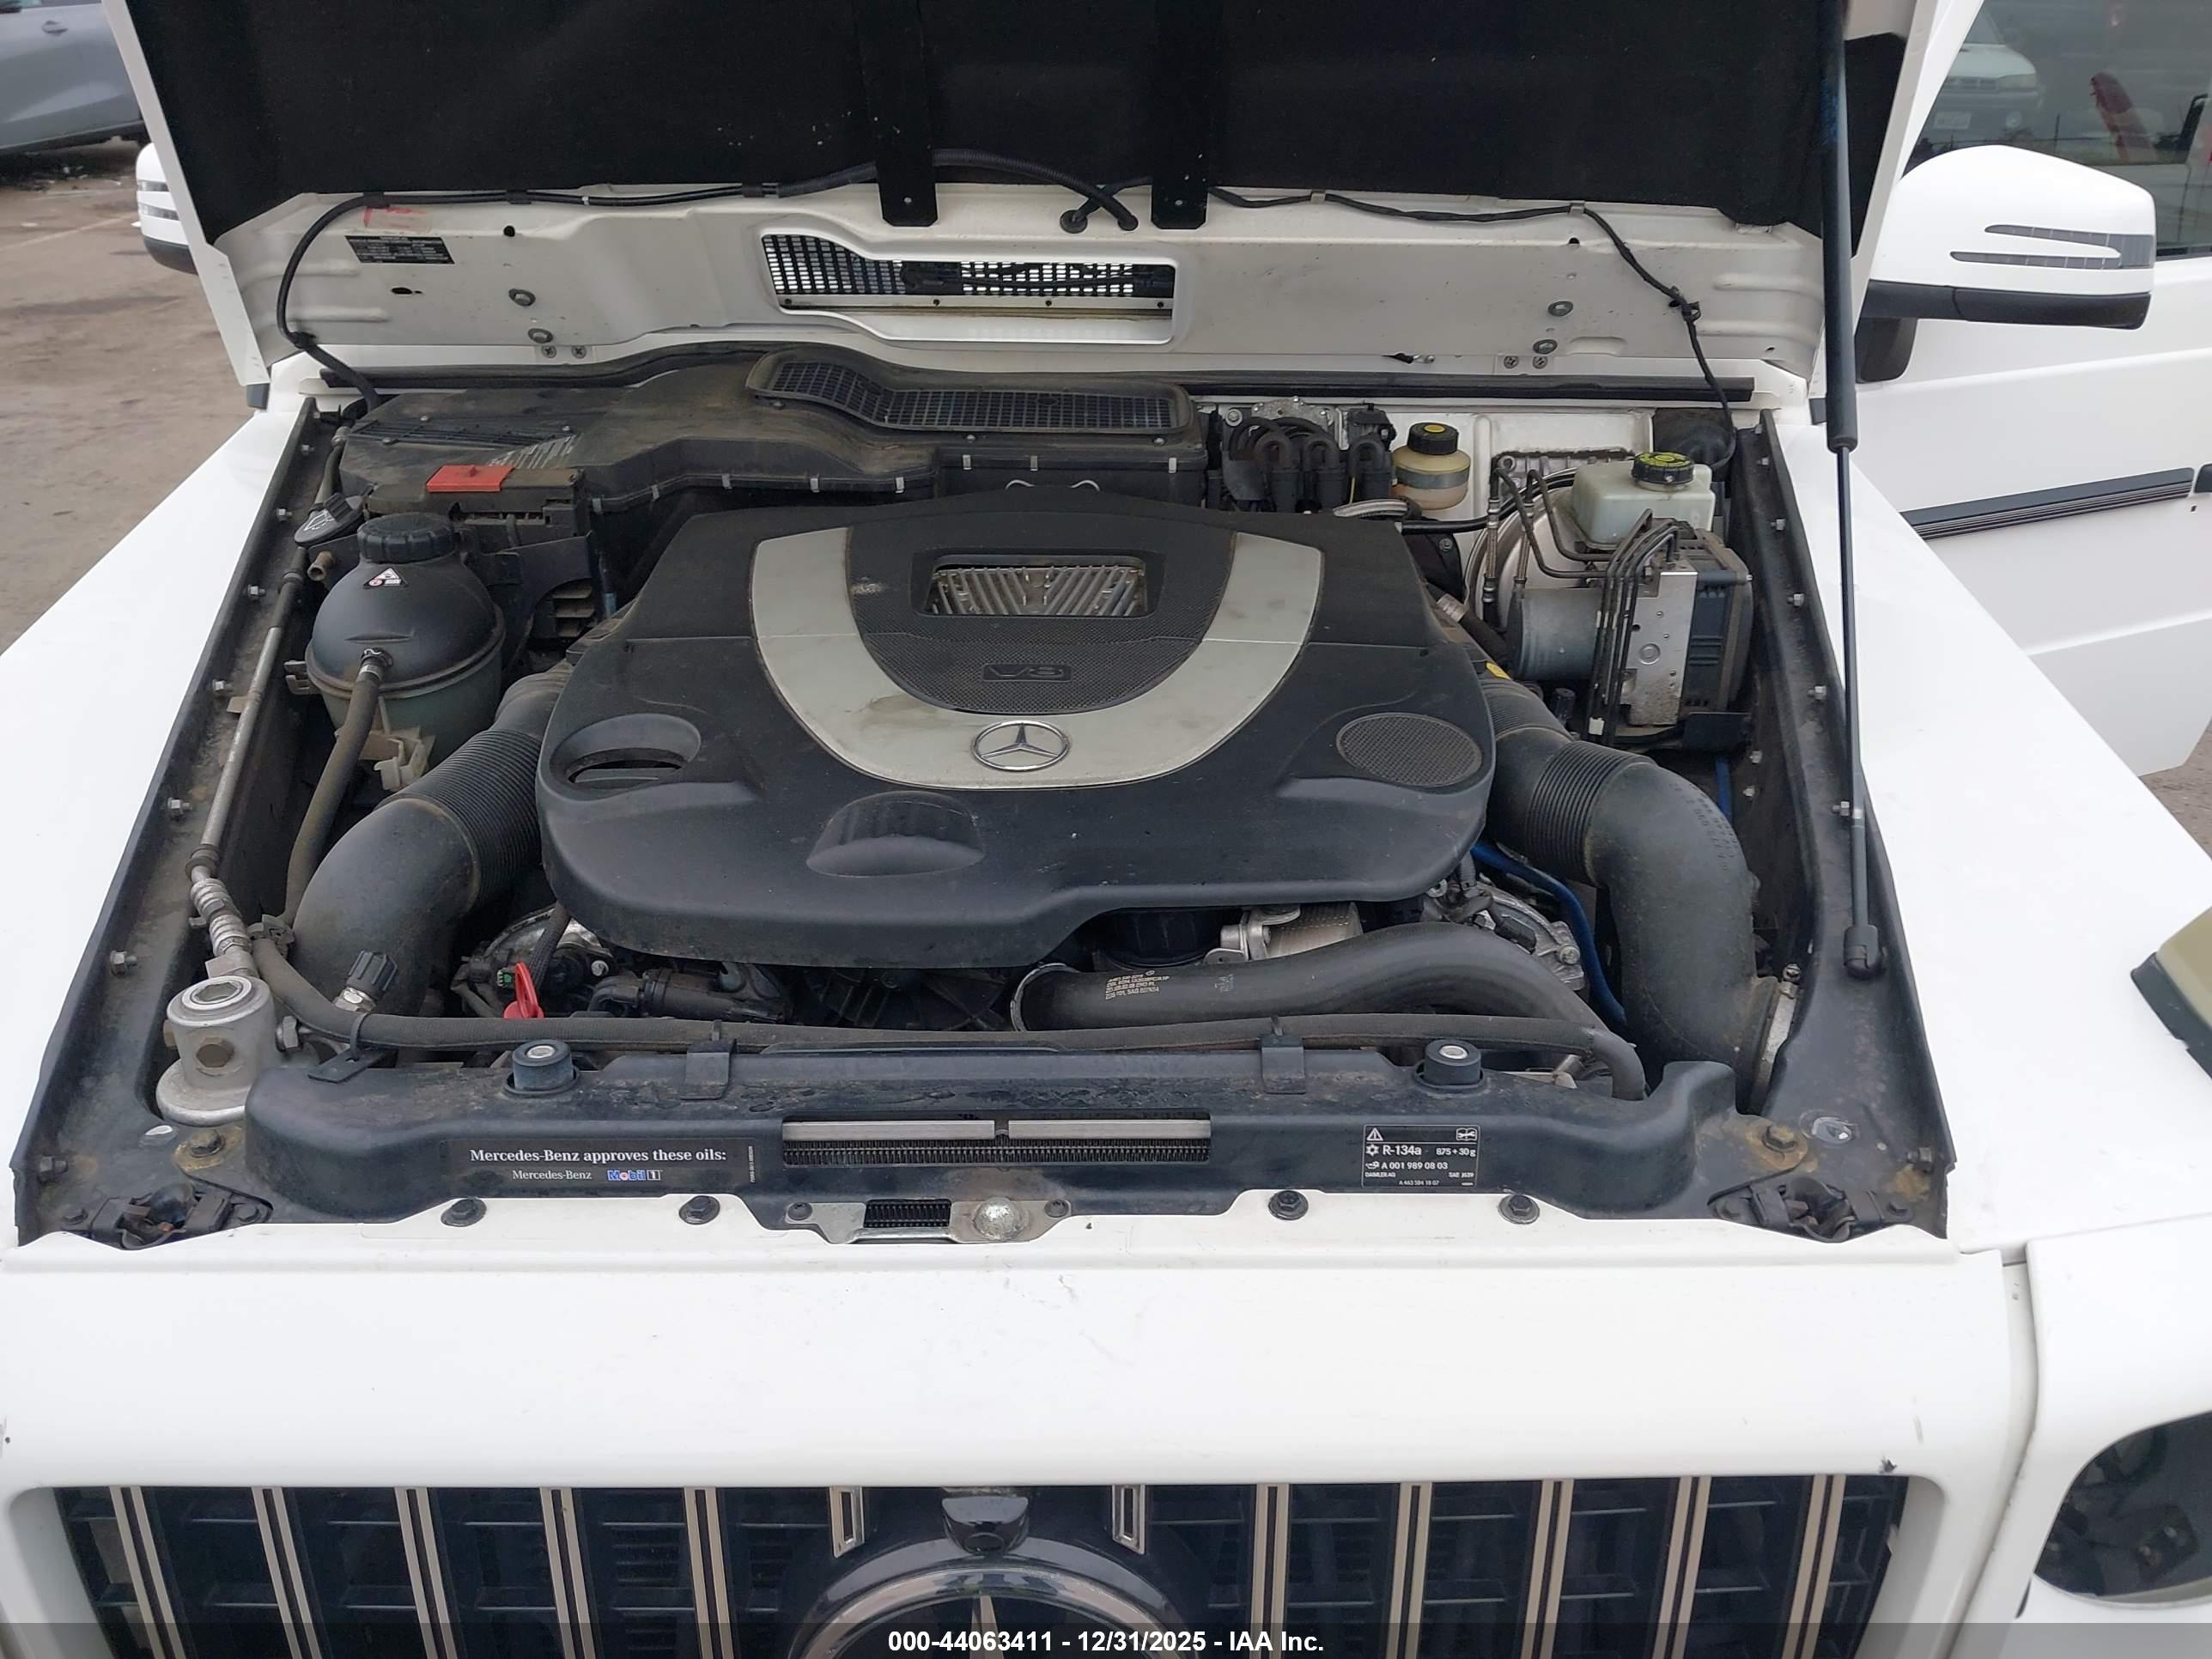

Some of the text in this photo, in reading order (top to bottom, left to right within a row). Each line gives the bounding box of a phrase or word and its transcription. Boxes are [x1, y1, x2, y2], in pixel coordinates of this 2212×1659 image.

[1382, 1145, 1422, 1155] R-134a
[470, 1149, 727, 1164] Mercedes-Benz approves these oils:
[512, 1170, 592, 1180] Mercedes-Benz
[607, 1170, 647, 1181] Mobil
